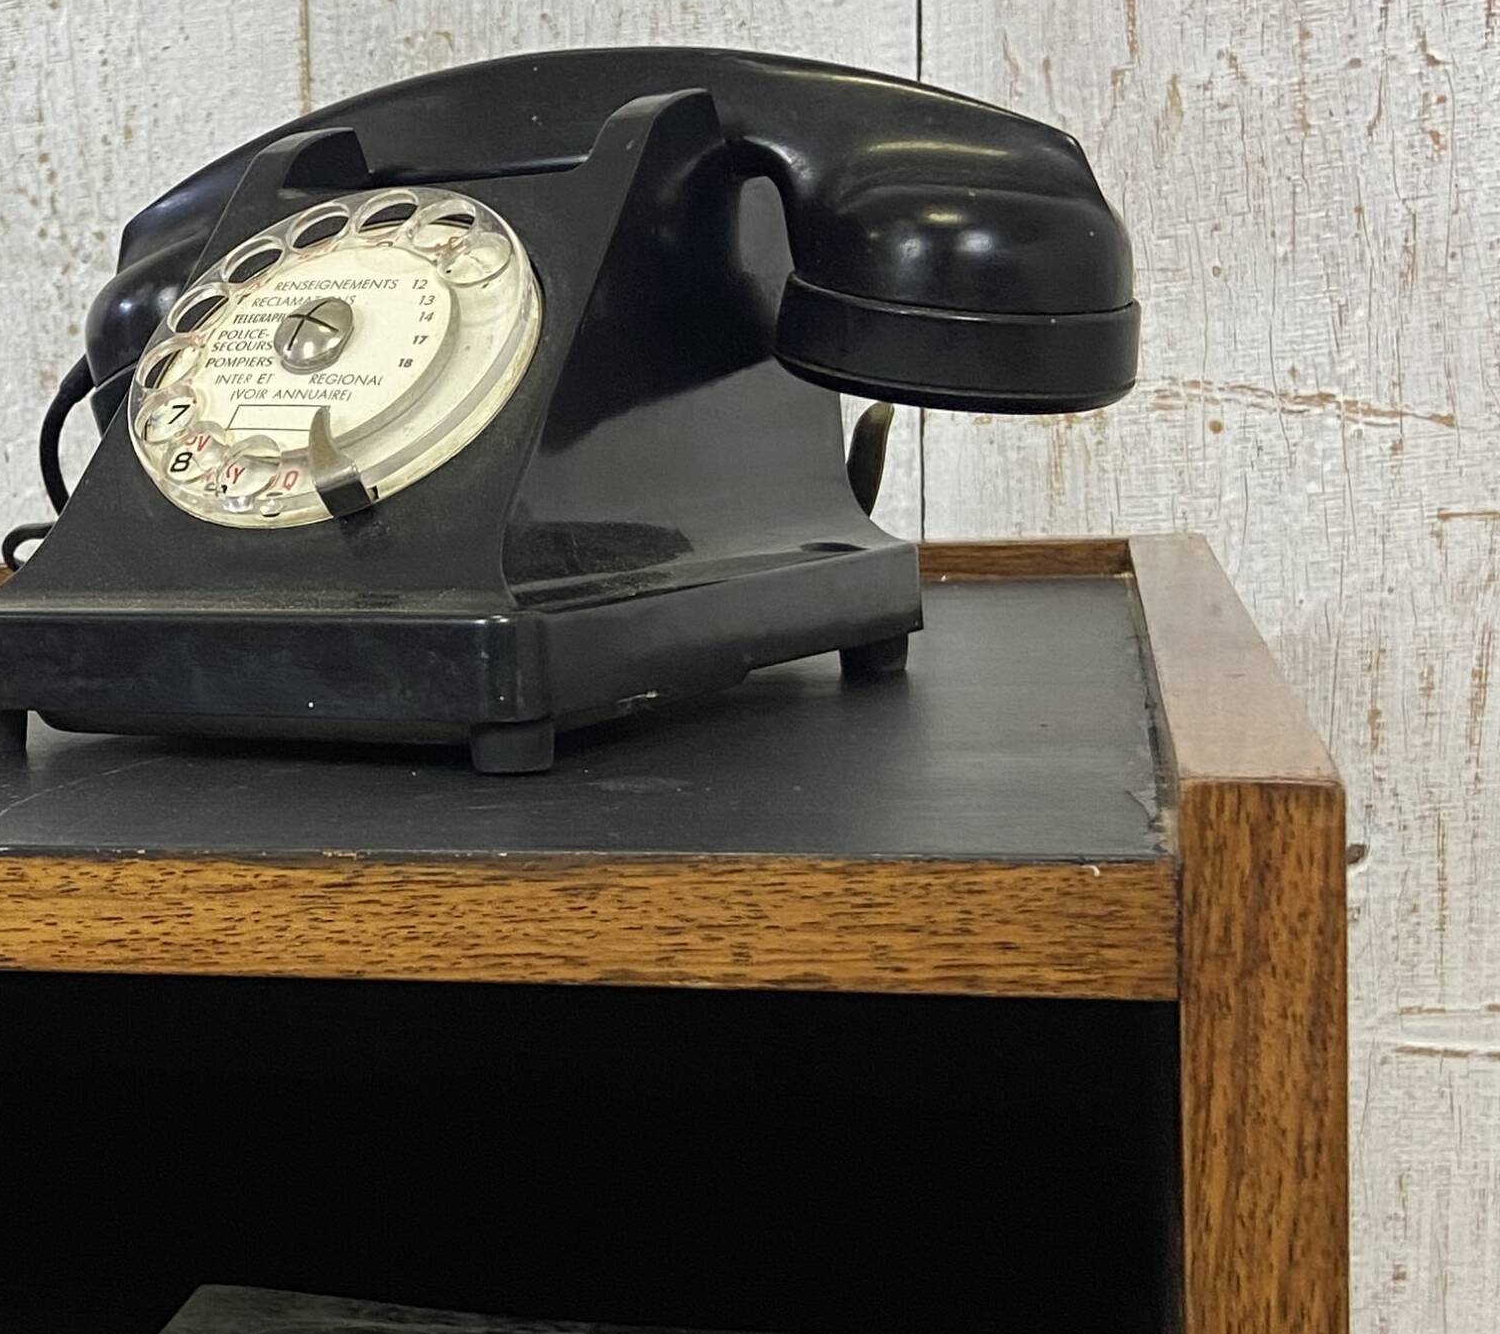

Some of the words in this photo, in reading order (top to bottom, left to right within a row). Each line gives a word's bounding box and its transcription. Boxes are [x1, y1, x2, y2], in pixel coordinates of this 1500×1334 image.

[274, 278, 399, 292] RENSEIGNEMENTS
[411, 278, 428, 290] 12
[252, 294, 357, 309] RECLAMS
[418, 294, 435, 306] 13
[418, 311, 435, 323] 14
[217, 328, 270, 340] POLICE-
[210, 340, 274, 352] SECOURS
[412, 334, 429, 345] 17
[204, 356, 275, 368] POMPIERS
[398, 358, 414, 368] 18
[214, 373, 254, 386] INTER
[256, 373, 276, 385] ET
[229, 388, 269, 402] (VOIR
[271, 389, 353, 402] ANNUAIRE)
[168, 404, 191, 424] 7
[169, 451, 194, 473] 8
